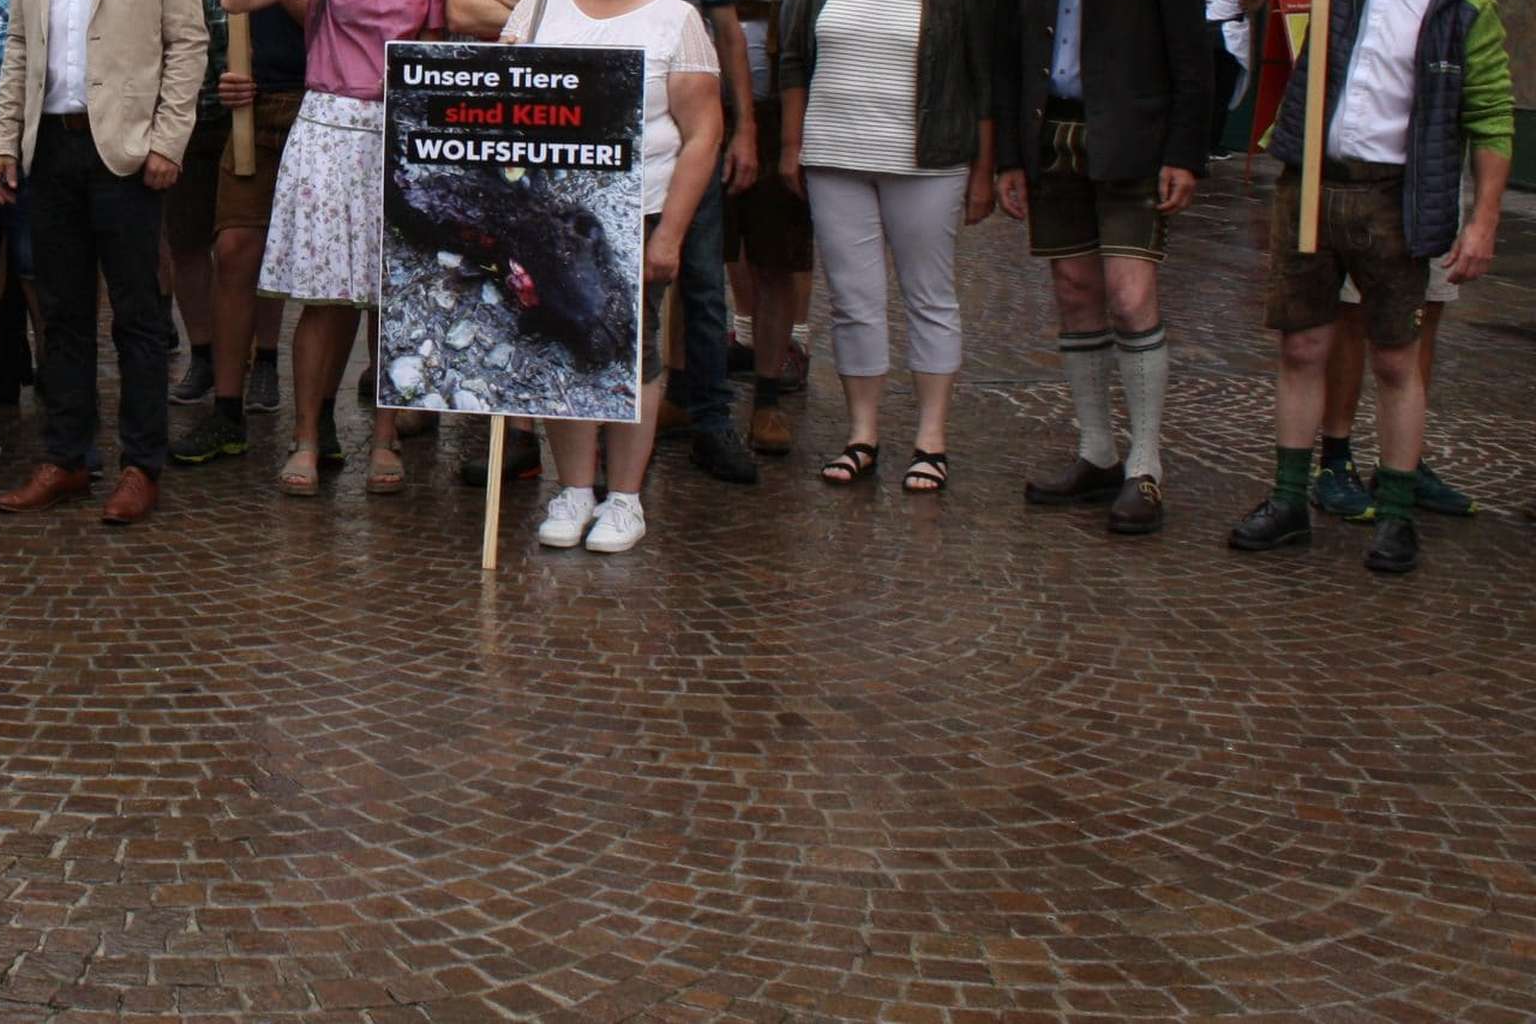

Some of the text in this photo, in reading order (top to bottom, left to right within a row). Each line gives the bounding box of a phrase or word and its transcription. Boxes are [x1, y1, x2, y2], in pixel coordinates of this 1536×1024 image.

[403, 64, 580, 90] Unsere Tiere
[444, 103, 583, 127] sind KEIN
[415, 138, 622, 166] WOLFSFUTTER!
